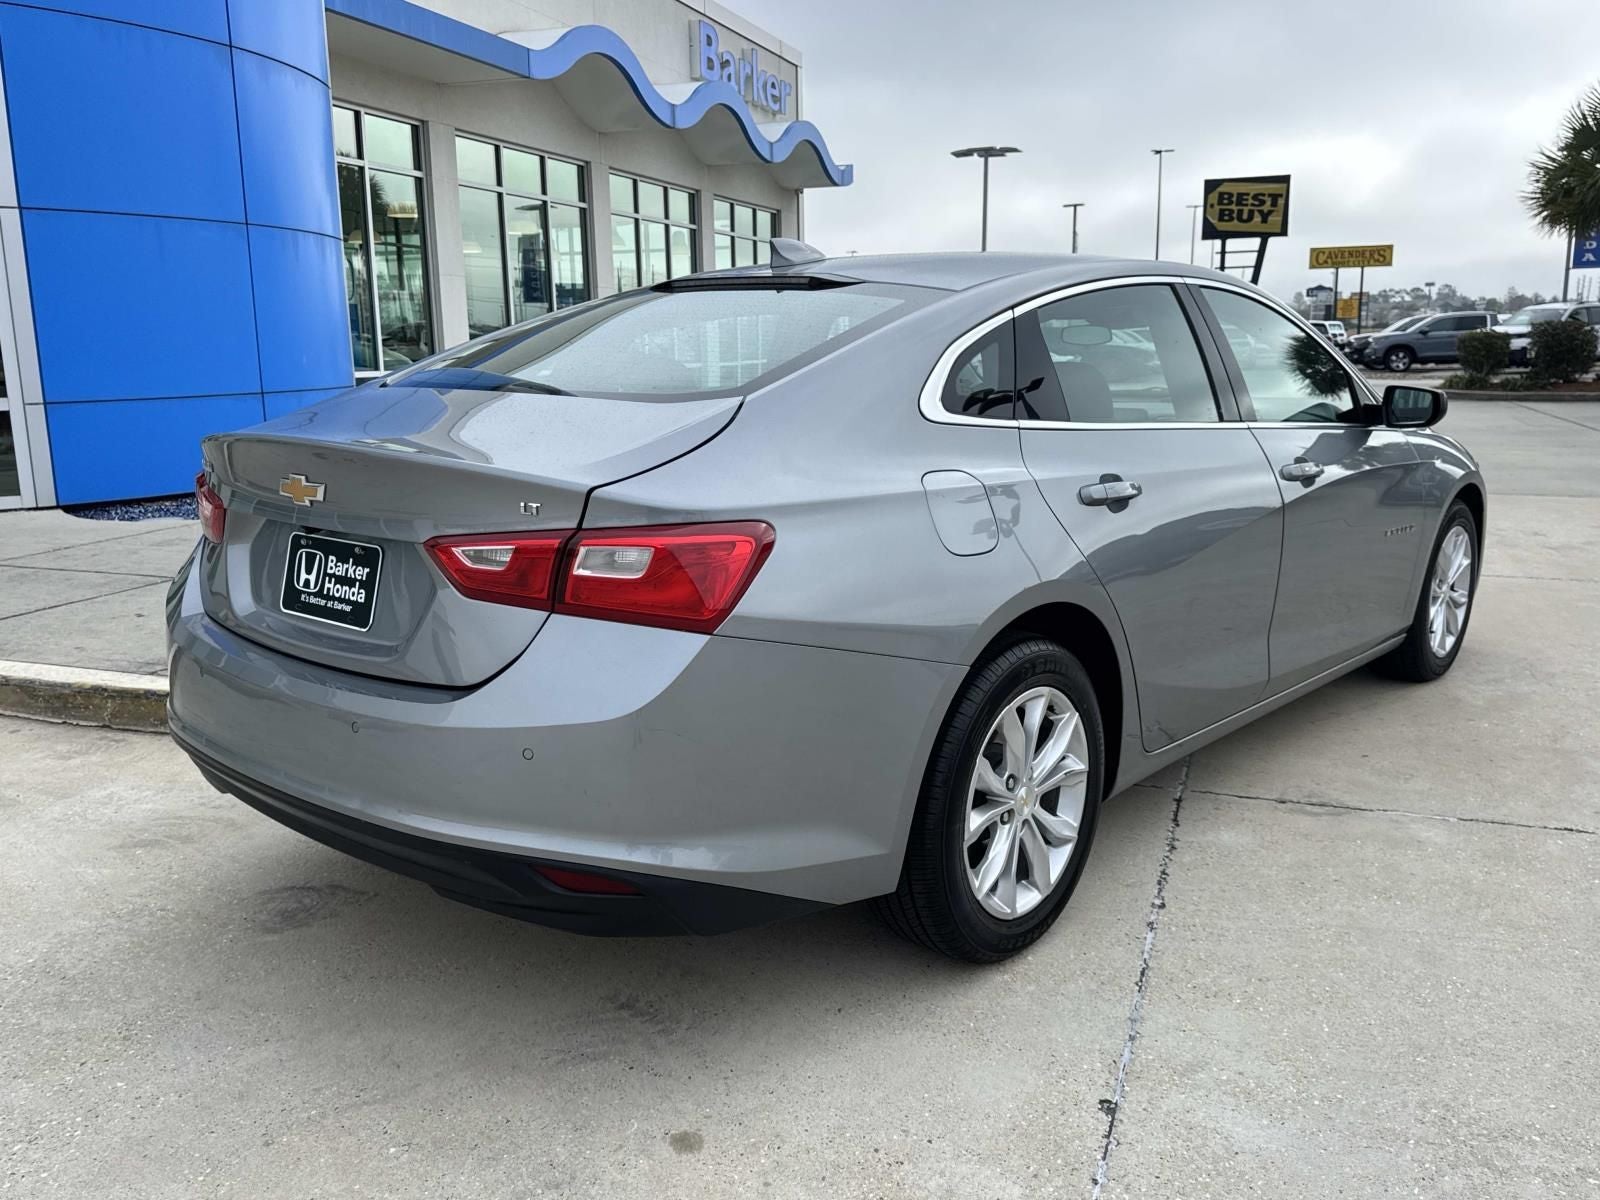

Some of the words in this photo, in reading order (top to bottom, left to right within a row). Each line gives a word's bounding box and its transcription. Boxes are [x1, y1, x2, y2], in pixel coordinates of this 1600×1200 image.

[697, 19, 792, 116] Barker
[1217, 191, 1283, 208] BEST
[1217, 208, 1276, 224] BUY
[520, 501, 541, 516] LT
[326, 555, 370, 581] Barker
[323, 576, 366, 603] Honda
[309, 595, 327, 606] Better
[327, 600, 334, 608] at
[333, 601, 353, 612] Barker
